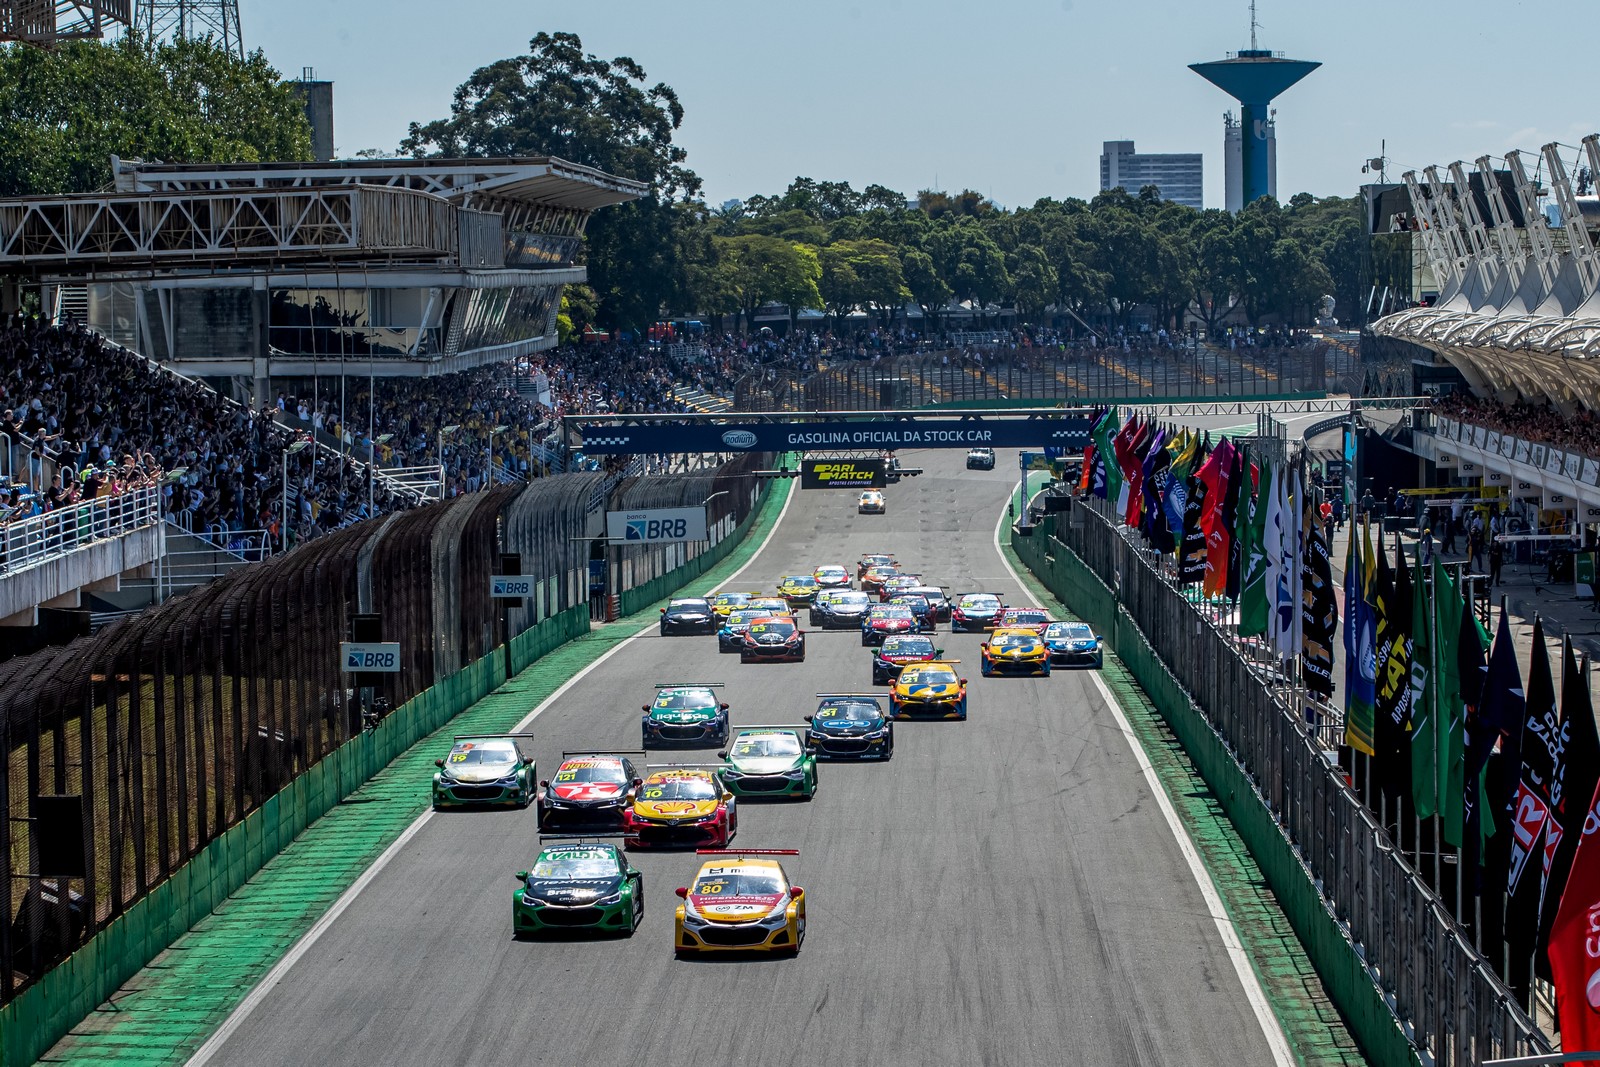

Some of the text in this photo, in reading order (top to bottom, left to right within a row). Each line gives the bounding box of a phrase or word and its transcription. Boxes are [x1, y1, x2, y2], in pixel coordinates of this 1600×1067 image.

[724, 432, 754, 446] podium
[788, 430, 992, 444] GASOLINA OFICIAL DA STOCK CAR
[815, 464, 855, 473] PARI
[820, 472, 874, 480] MATCH
[647, 519, 687, 539] BRB
[506, 582, 529, 594] BRB
[363, 652, 394, 668] BRB
[740, 746, 750, 754] 4
[452, 755, 467, 763] 19
[558, 773, 576, 781] 121
[645, 790, 663, 798] 10
[552, 852, 604, 860] VALDA
[701, 885, 722, 895] 80
